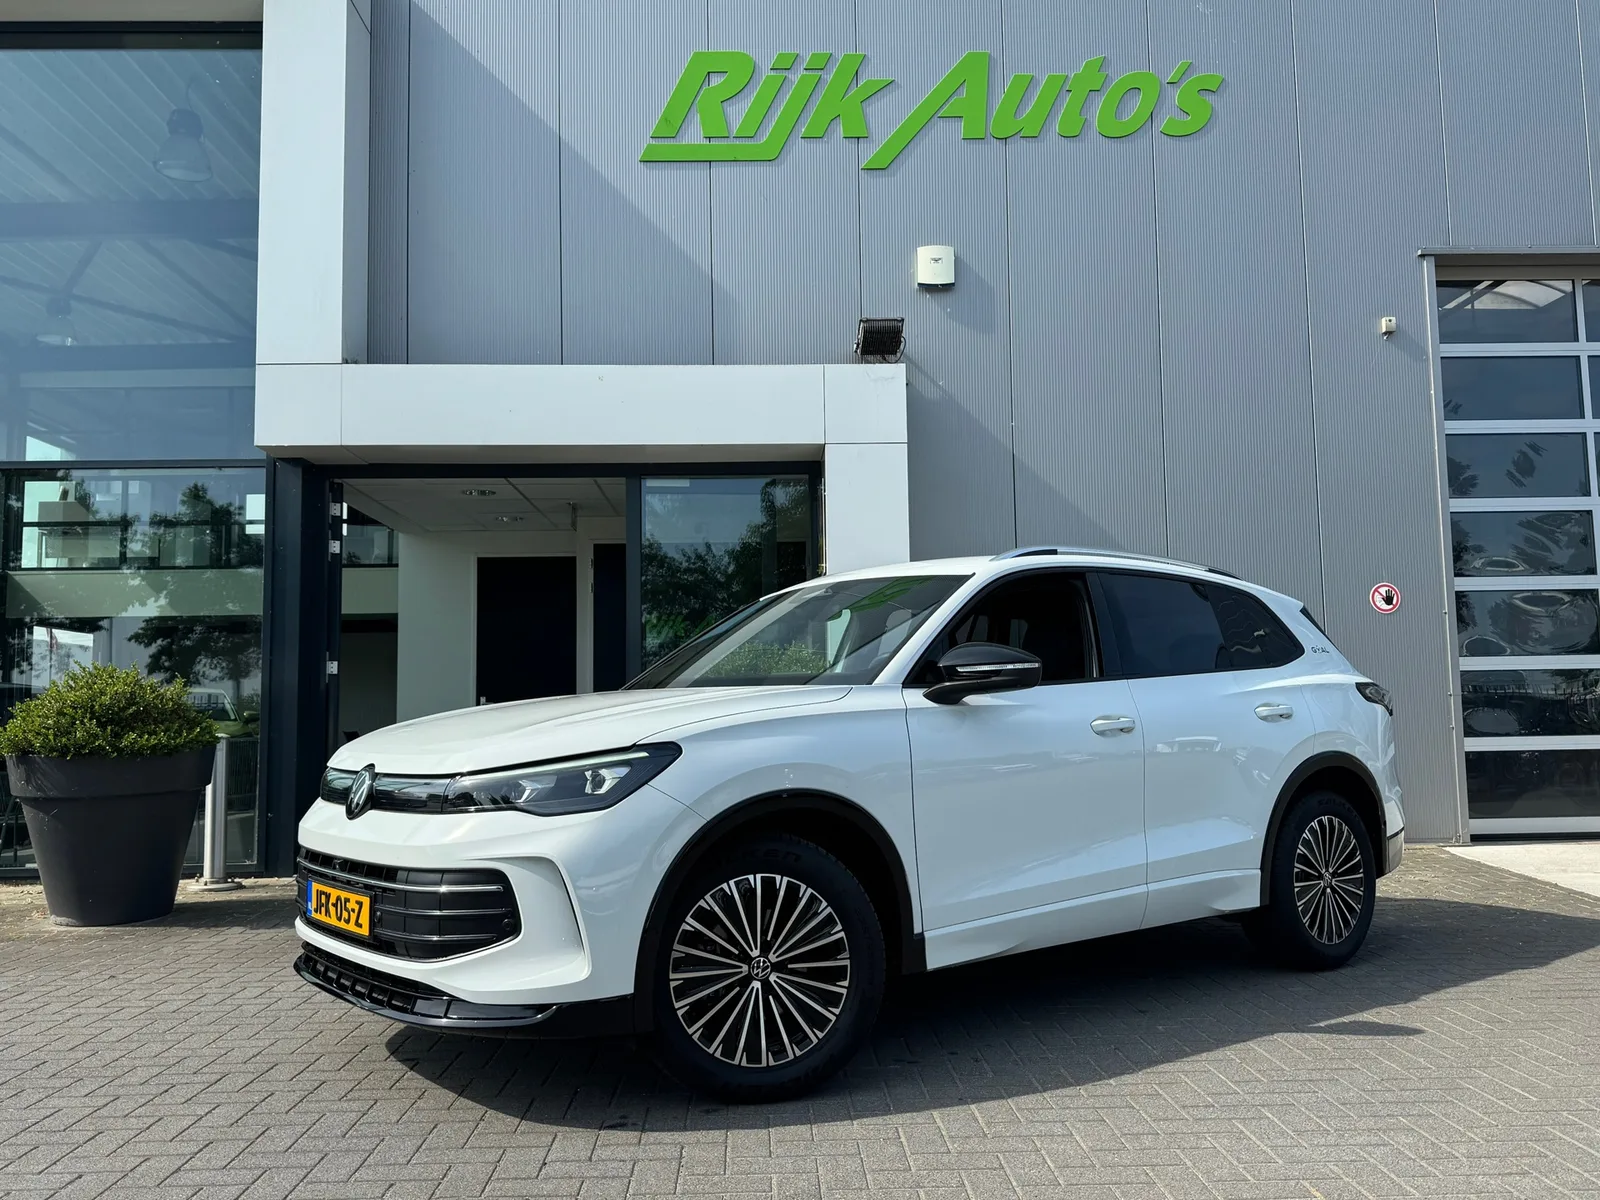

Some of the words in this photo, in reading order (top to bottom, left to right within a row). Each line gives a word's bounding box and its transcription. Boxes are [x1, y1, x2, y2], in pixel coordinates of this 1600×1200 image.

[640, 51, 896, 162] Rijk
[861, 51, 1224, 170] Auto's
[313, 888, 364, 929] JFK-05-Z
